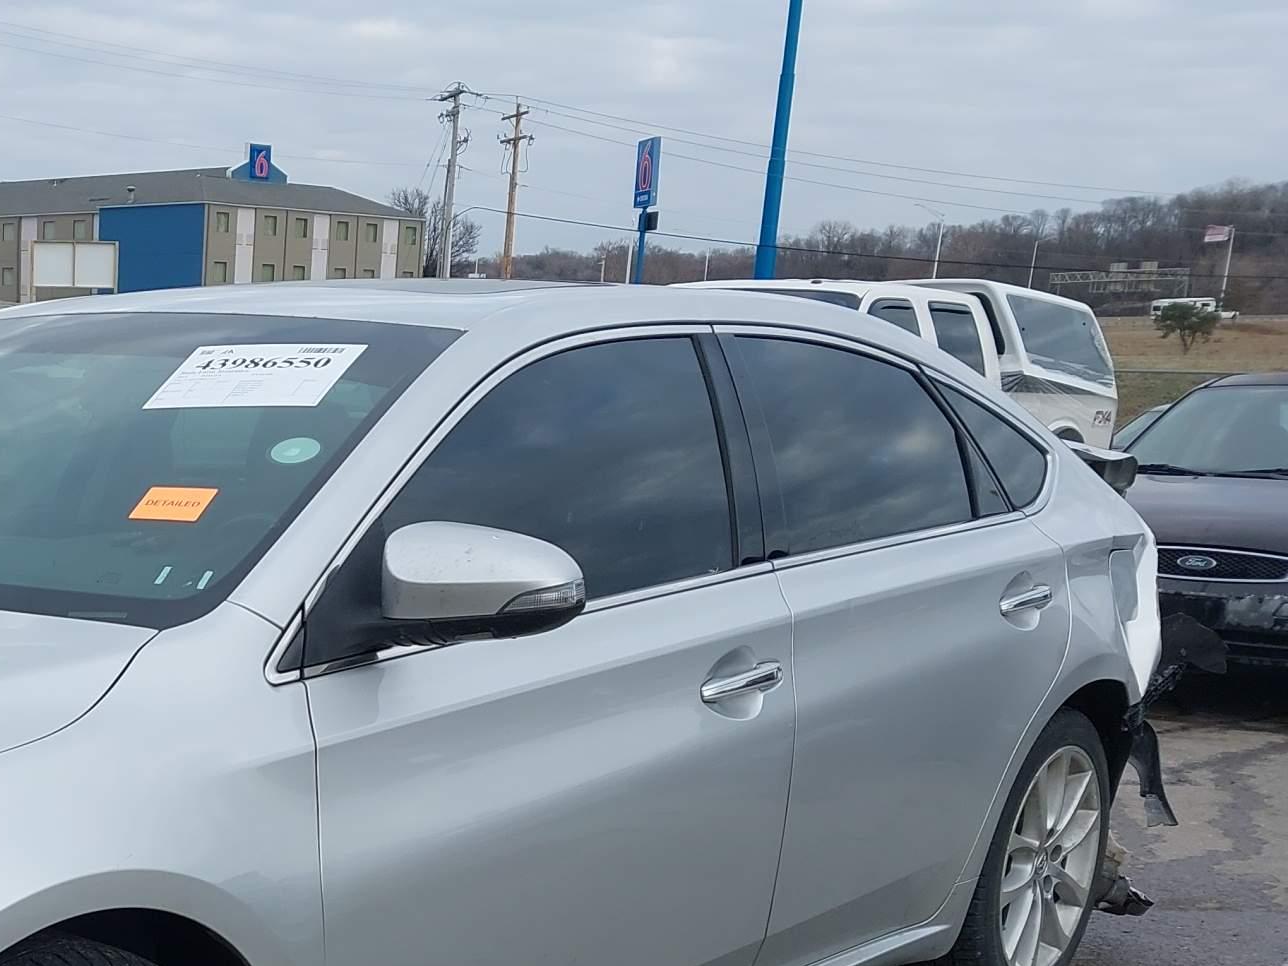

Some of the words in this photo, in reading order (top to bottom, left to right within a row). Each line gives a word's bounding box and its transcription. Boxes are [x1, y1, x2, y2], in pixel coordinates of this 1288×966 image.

[255, 150, 269, 177] 6
[639, 140, 652, 191] 6
[195, 356, 332, 370] 43986550
[144, 499, 201, 507] DETAILED
